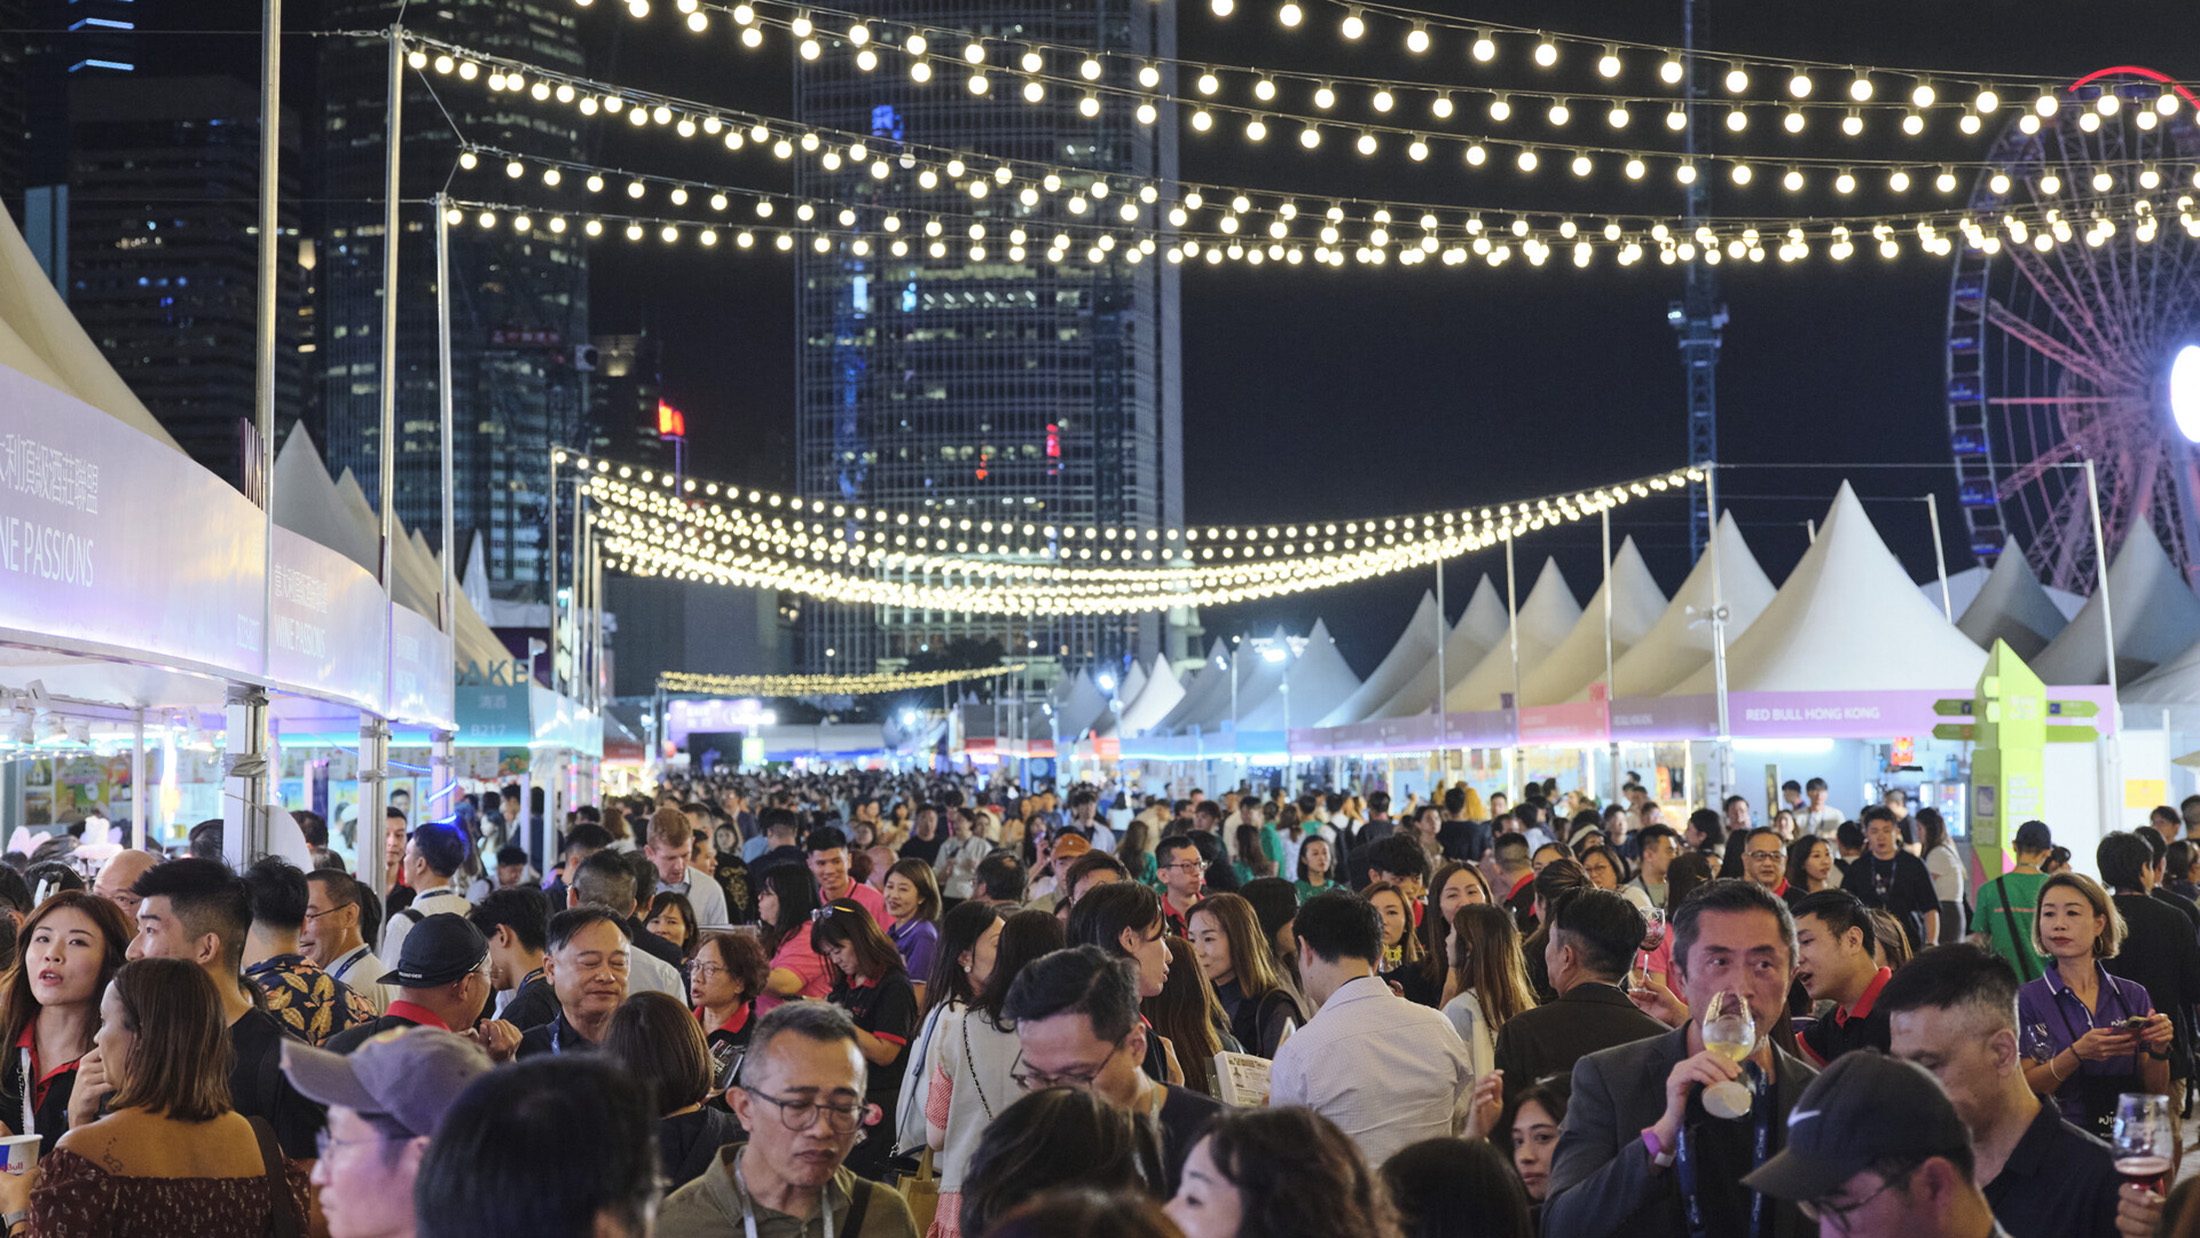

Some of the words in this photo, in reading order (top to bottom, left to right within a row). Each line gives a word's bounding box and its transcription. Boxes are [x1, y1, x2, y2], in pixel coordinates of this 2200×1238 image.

[24, 521, 94, 588] PASSIONS
[1745, 709, 1770, 721] RED
[1772, 708, 1803, 721] BULL
[1805, 708, 1842, 720] HONG
[1844, 707, 1880, 719] KONG
[471, 724, 506, 737] B217
